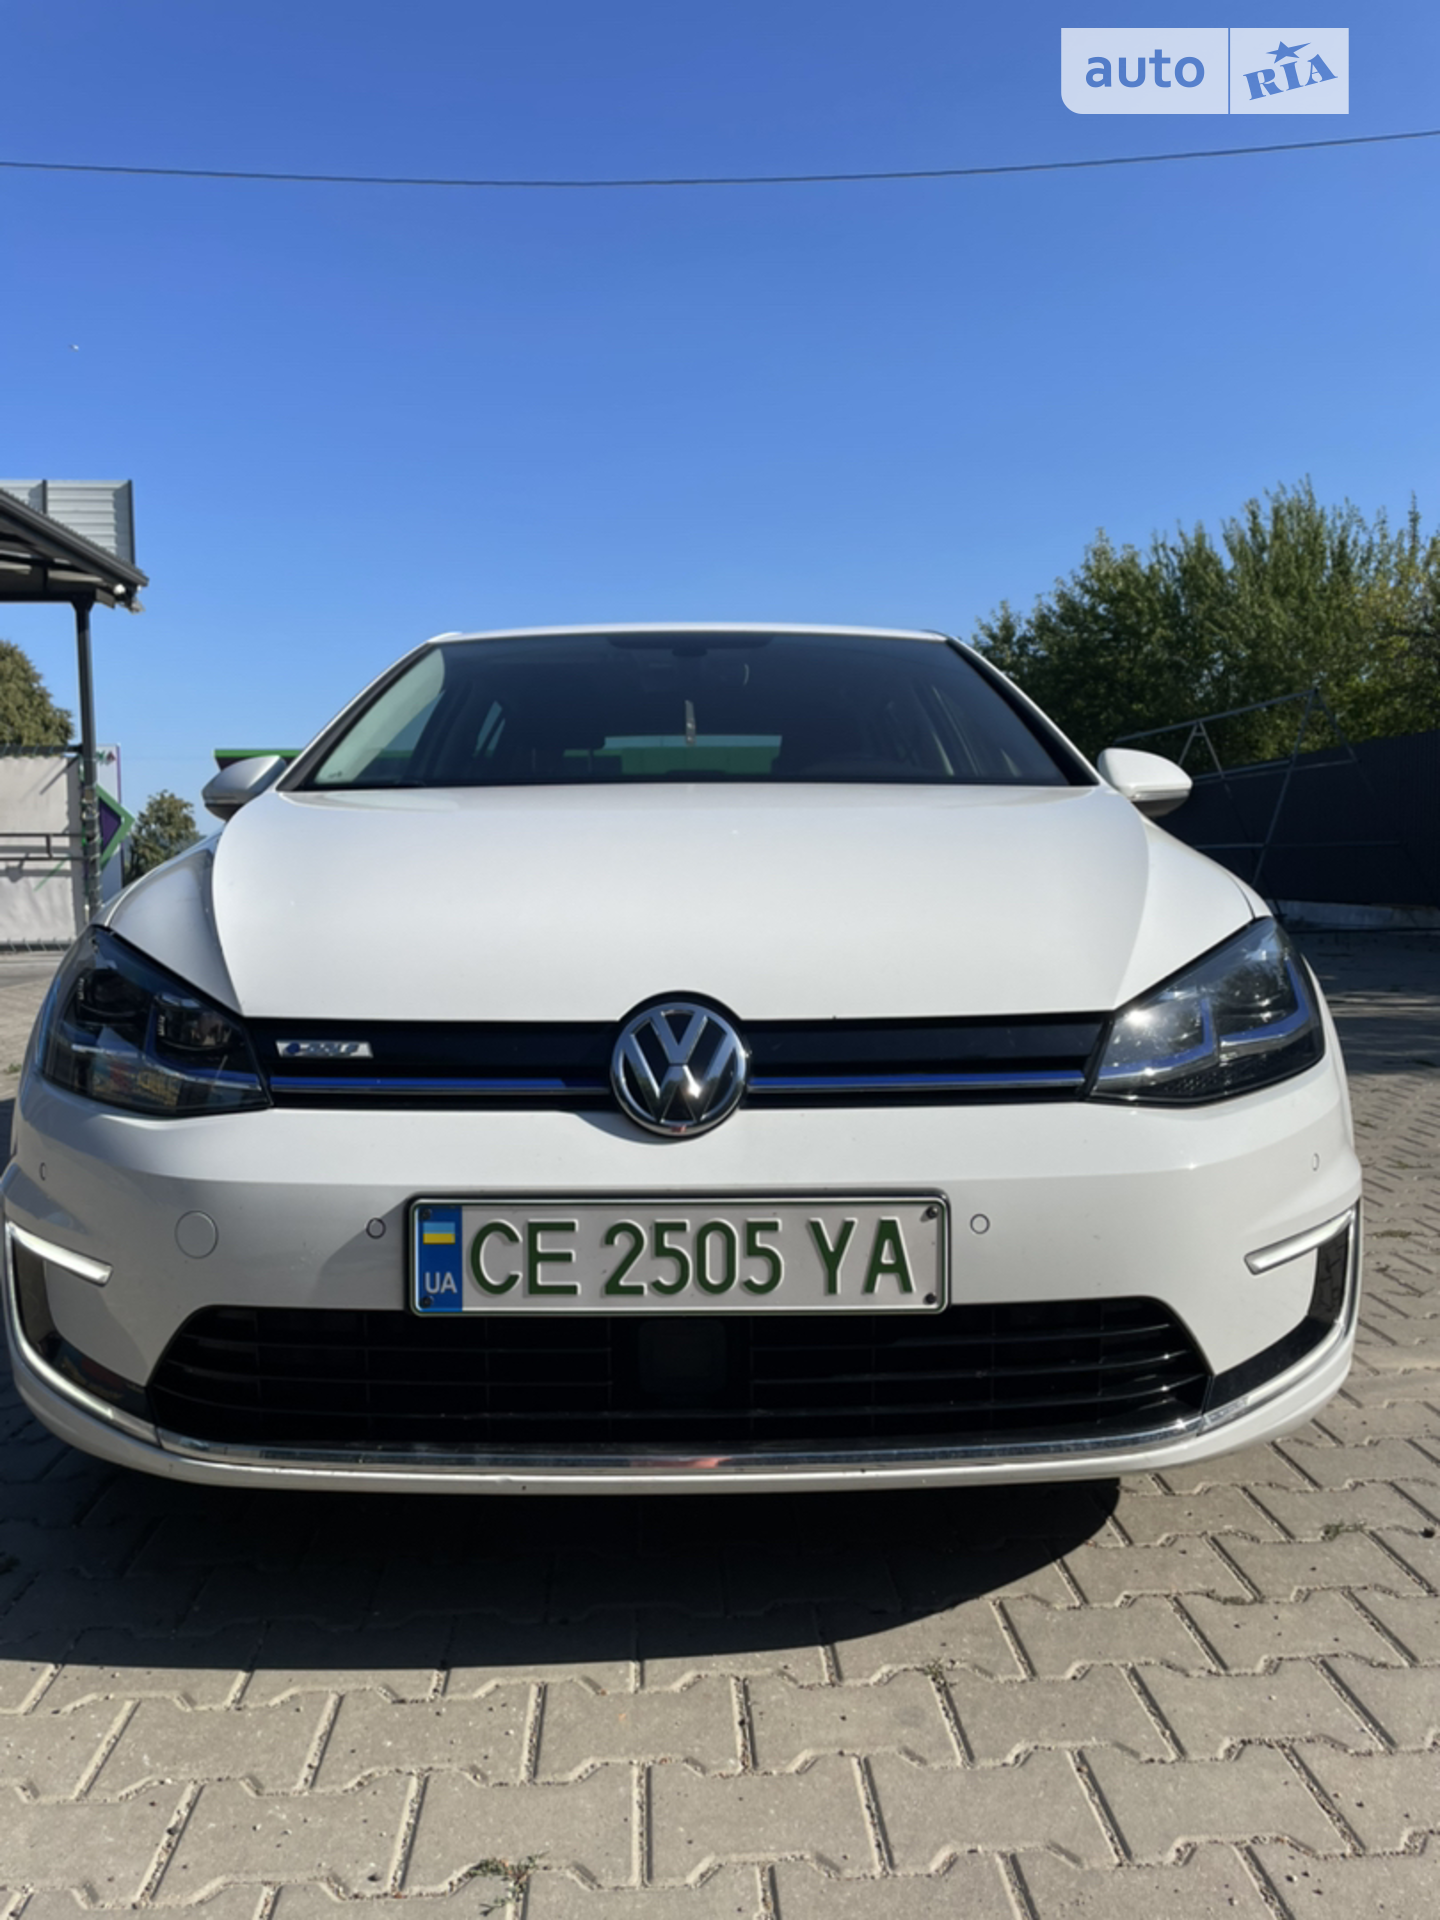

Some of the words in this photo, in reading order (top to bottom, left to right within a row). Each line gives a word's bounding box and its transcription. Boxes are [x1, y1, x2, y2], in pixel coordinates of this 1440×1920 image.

[470, 1219, 580, 1295] CE
[604, 1219, 785, 1295] 2505
[808, 1217, 916, 1295] YA
[424, 1273, 458, 1294] UA
